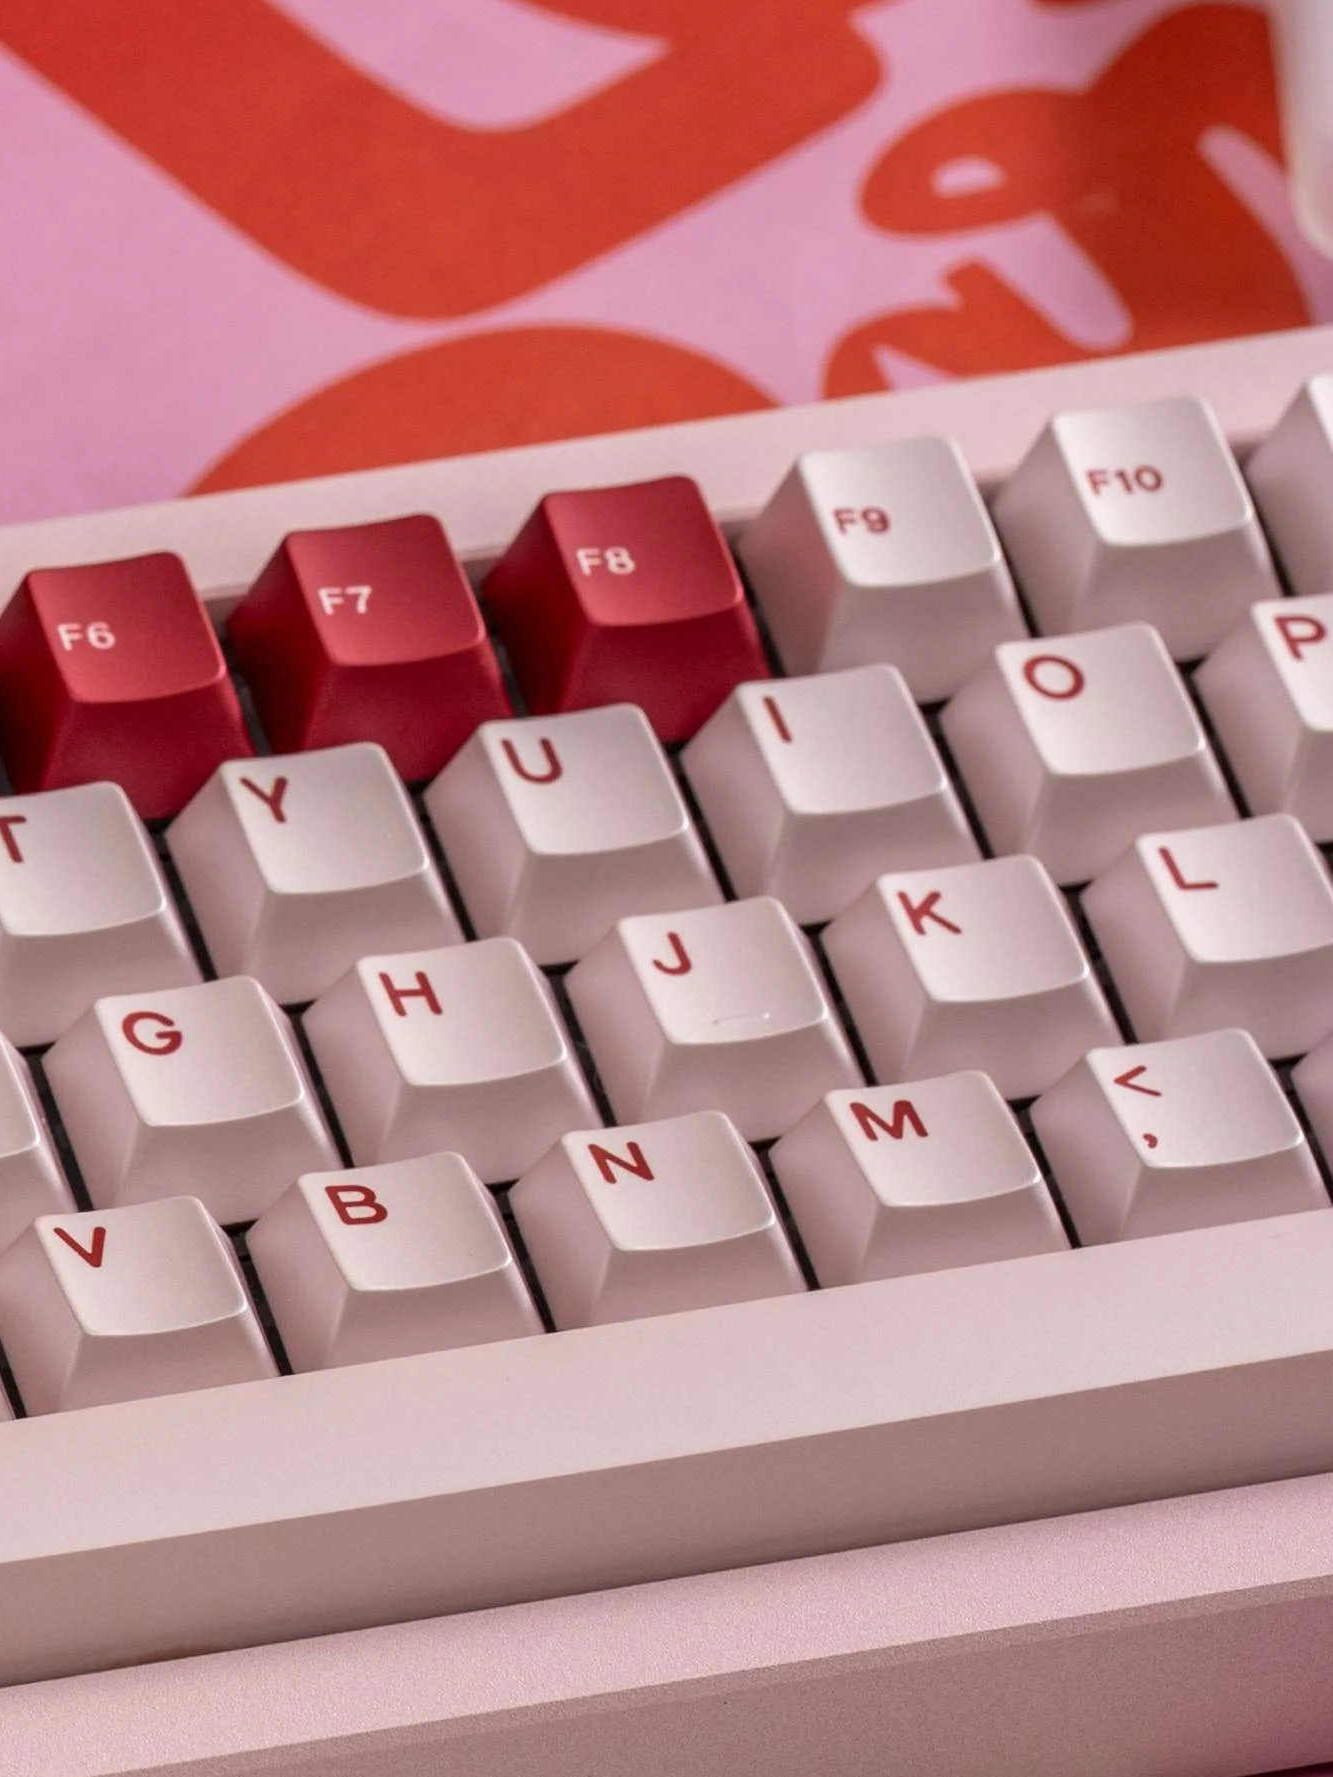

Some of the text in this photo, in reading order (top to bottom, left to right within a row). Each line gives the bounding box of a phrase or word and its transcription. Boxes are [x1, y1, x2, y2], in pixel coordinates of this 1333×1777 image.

[1088, 465, 1165, 494] F10
[834, 507, 891, 534] F9
[576, 548, 635, 576] F8
[318, 586, 371, 615] F7
[57, 623, 115, 651] F6
[1275, 615, 1328, 660] P
[1023, 655, 1085, 700] O
[763, 696, 792, 743] I
[502, 738, 562, 784] U
[240, 776, 288, 823] Y
[1159, 848, 1219, 890] L
[898, 891, 961, 935] K
[653, 932, 692, 975] J
[379, 972, 442, 1016] H
[122, 1012, 182, 1055] G
[850, 1100, 928, 1140] M
[588, 1142, 654, 1184] N
[325, 1185, 388, 1225] B
[54, 1227, 106, 1268] V
